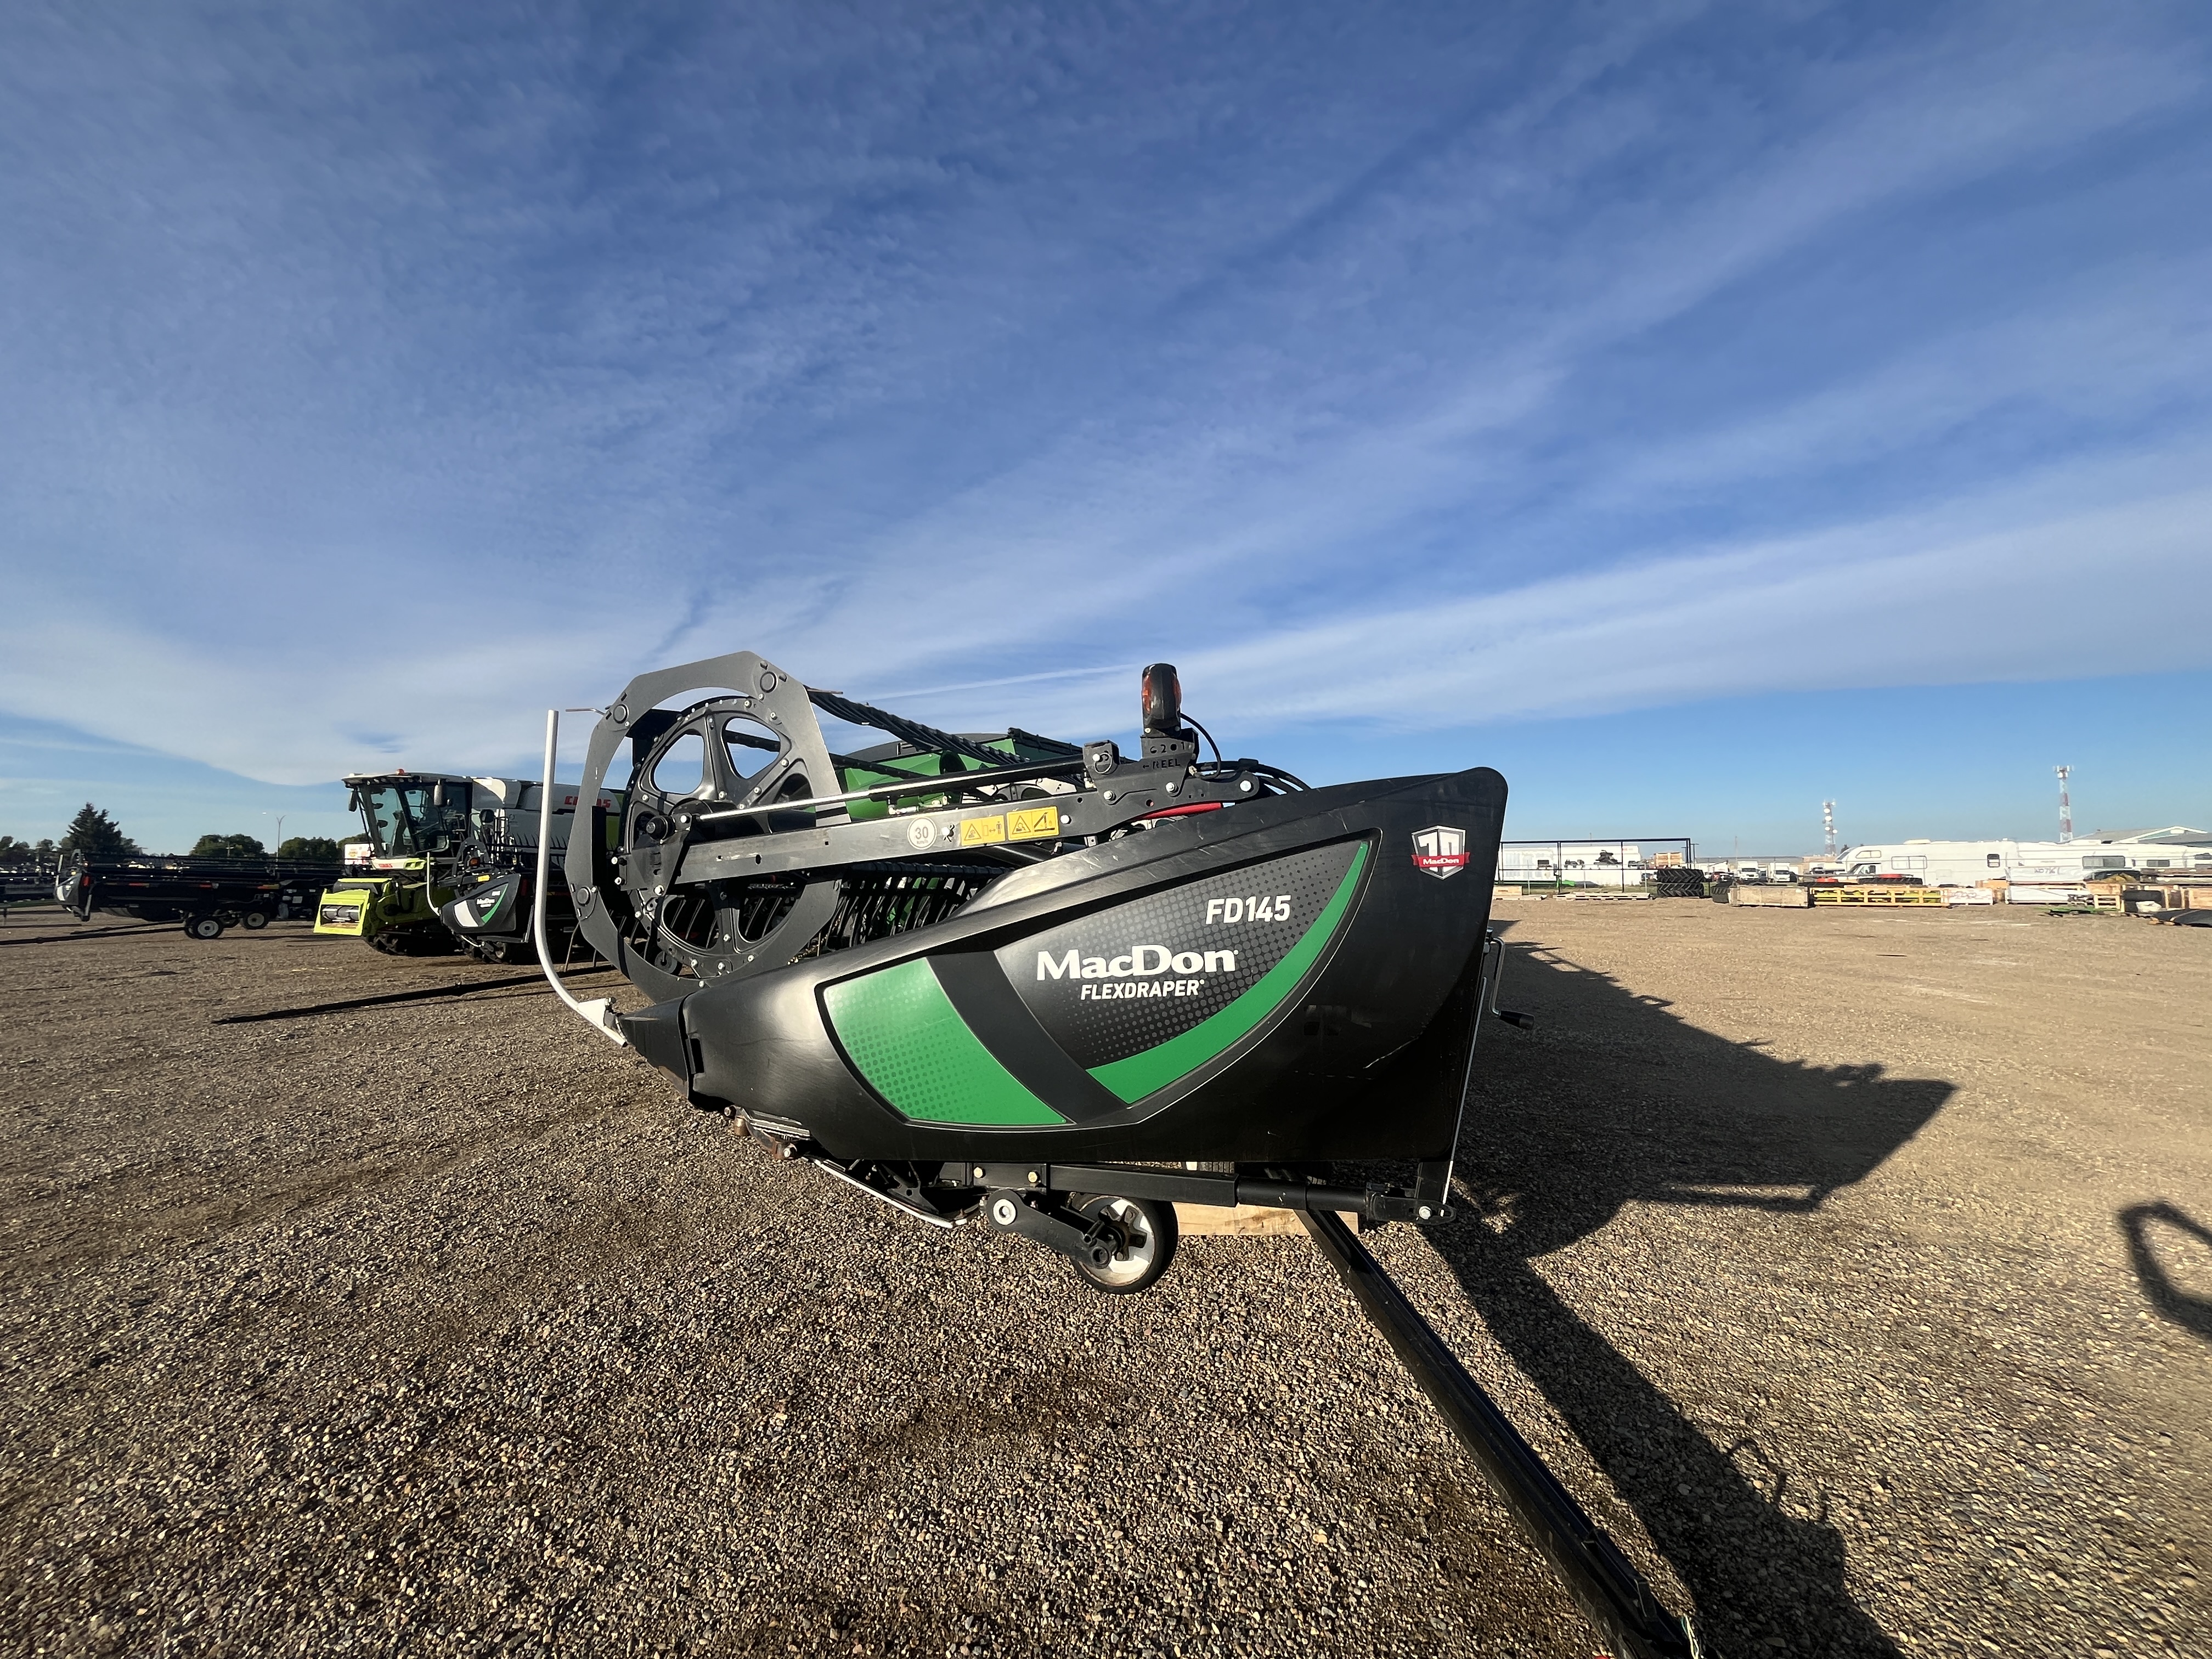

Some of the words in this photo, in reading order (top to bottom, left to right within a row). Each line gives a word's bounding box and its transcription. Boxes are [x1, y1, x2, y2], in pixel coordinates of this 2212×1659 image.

[1153, 758, 1181, 769] REEL
[915, 826, 929, 839] 30
[1206, 895, 1291, 925] FD145
[1036, 944, 1236, 981] MacDon
[1081, 979, 1200, 1000] FLEXDRAPER
